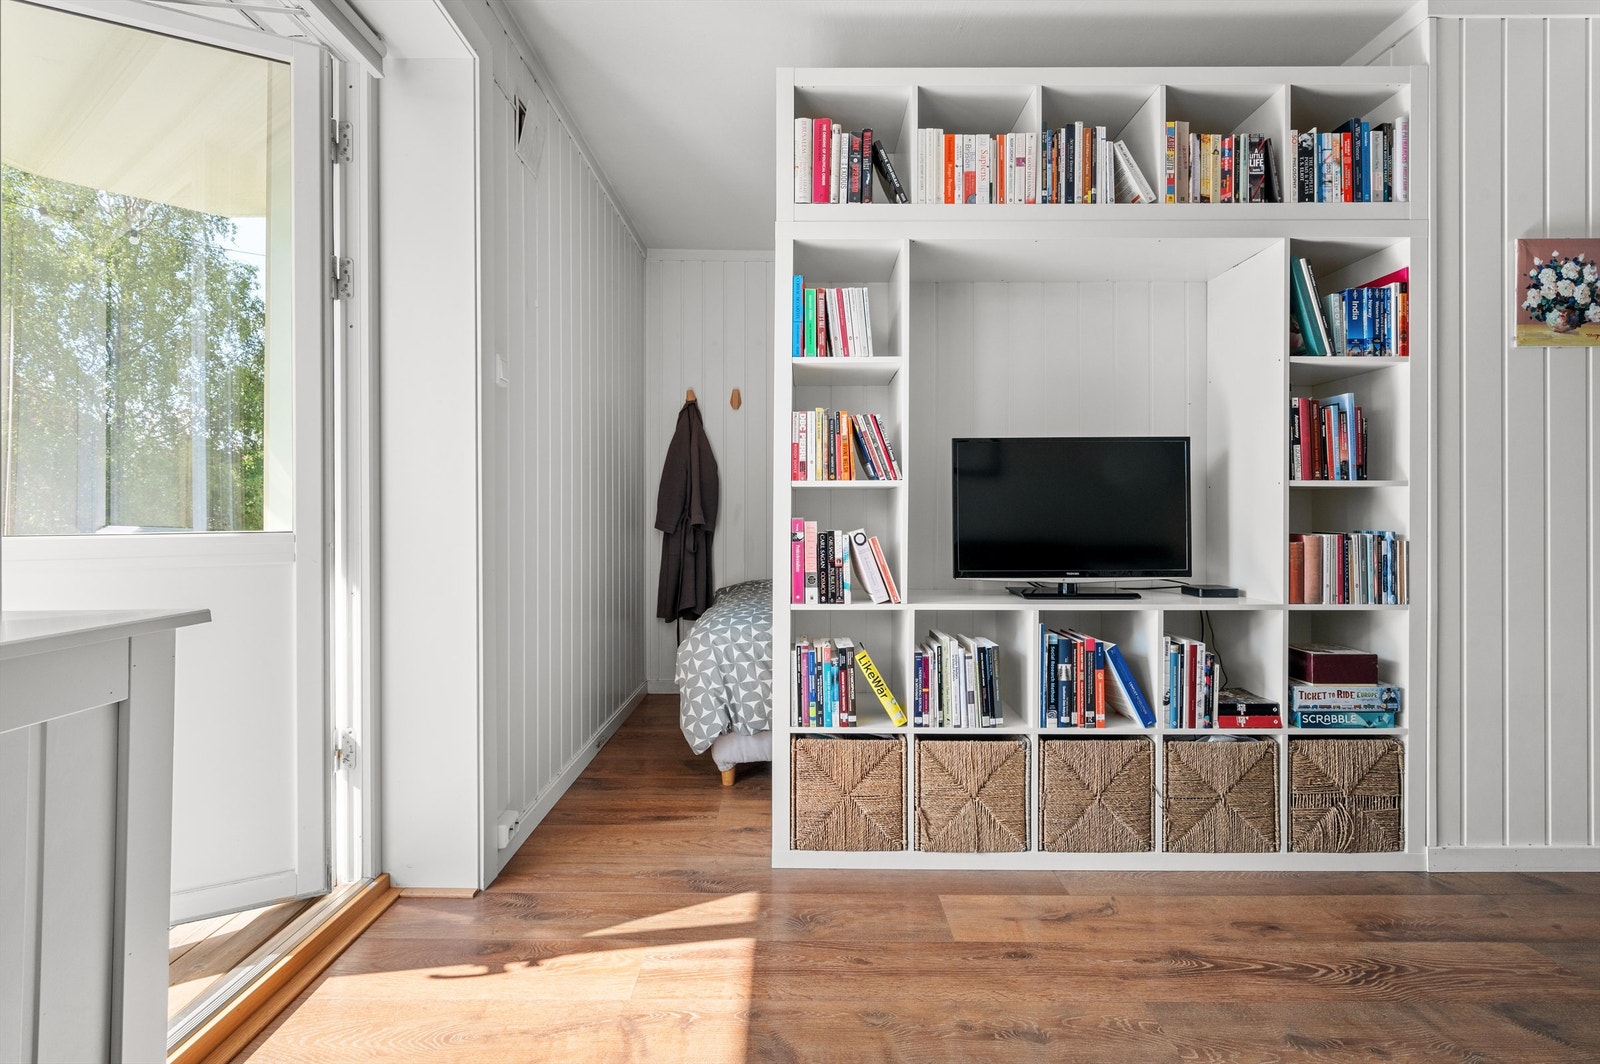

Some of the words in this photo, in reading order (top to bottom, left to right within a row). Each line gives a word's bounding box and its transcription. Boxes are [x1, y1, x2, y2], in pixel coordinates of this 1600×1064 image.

[979, 149, 989, 181] Sapiens
[858, 655, 887, 698] LikeWar
[1298, 690, 1327, 700] TICKET
[1337, 690, 1355, 699] RIDE
[1302, 715, 1357, 725] SCRABBLE
